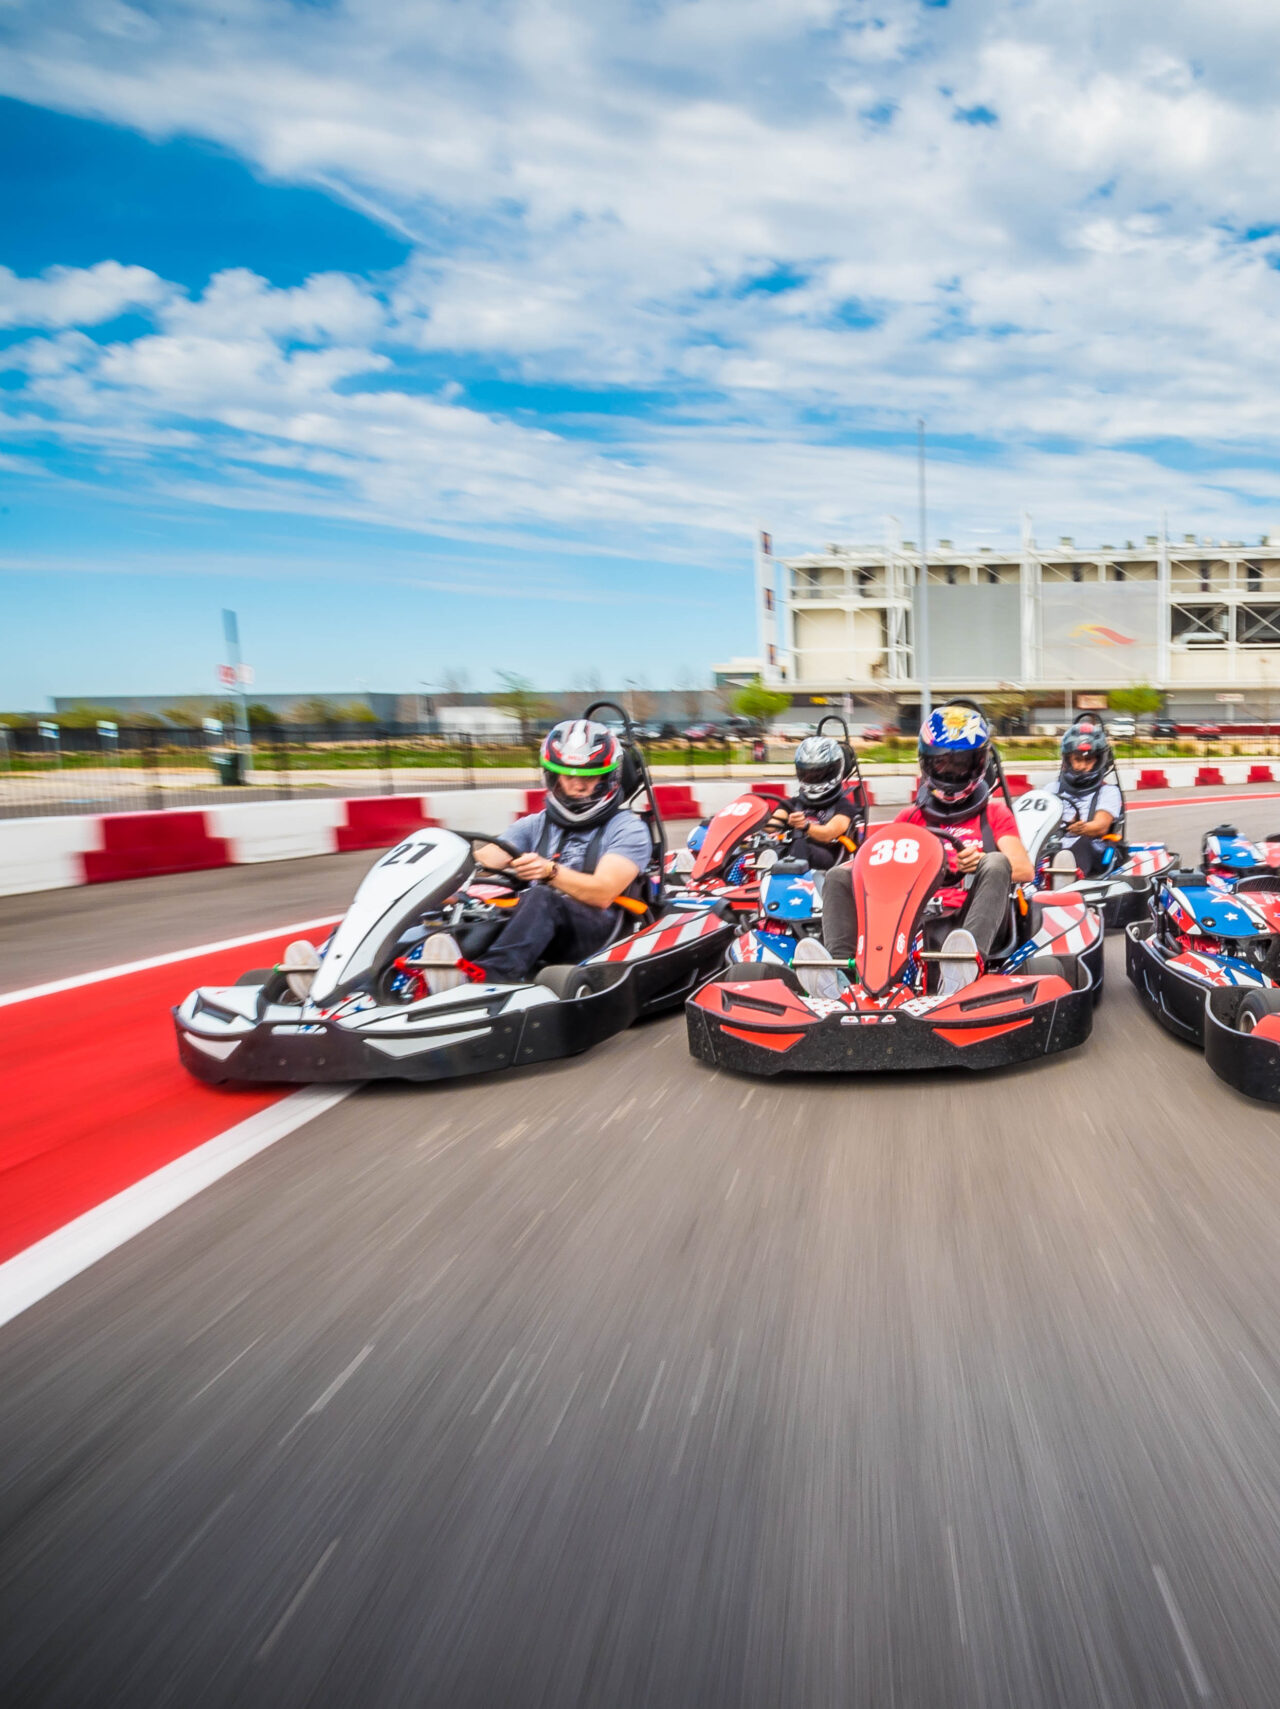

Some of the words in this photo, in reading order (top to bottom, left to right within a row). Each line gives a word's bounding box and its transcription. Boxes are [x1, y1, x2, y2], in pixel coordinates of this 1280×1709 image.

[1018, 798, 1048, 812] 26
[379, 842, 439, 867] 27
[869, 838, 919, 865] 38
